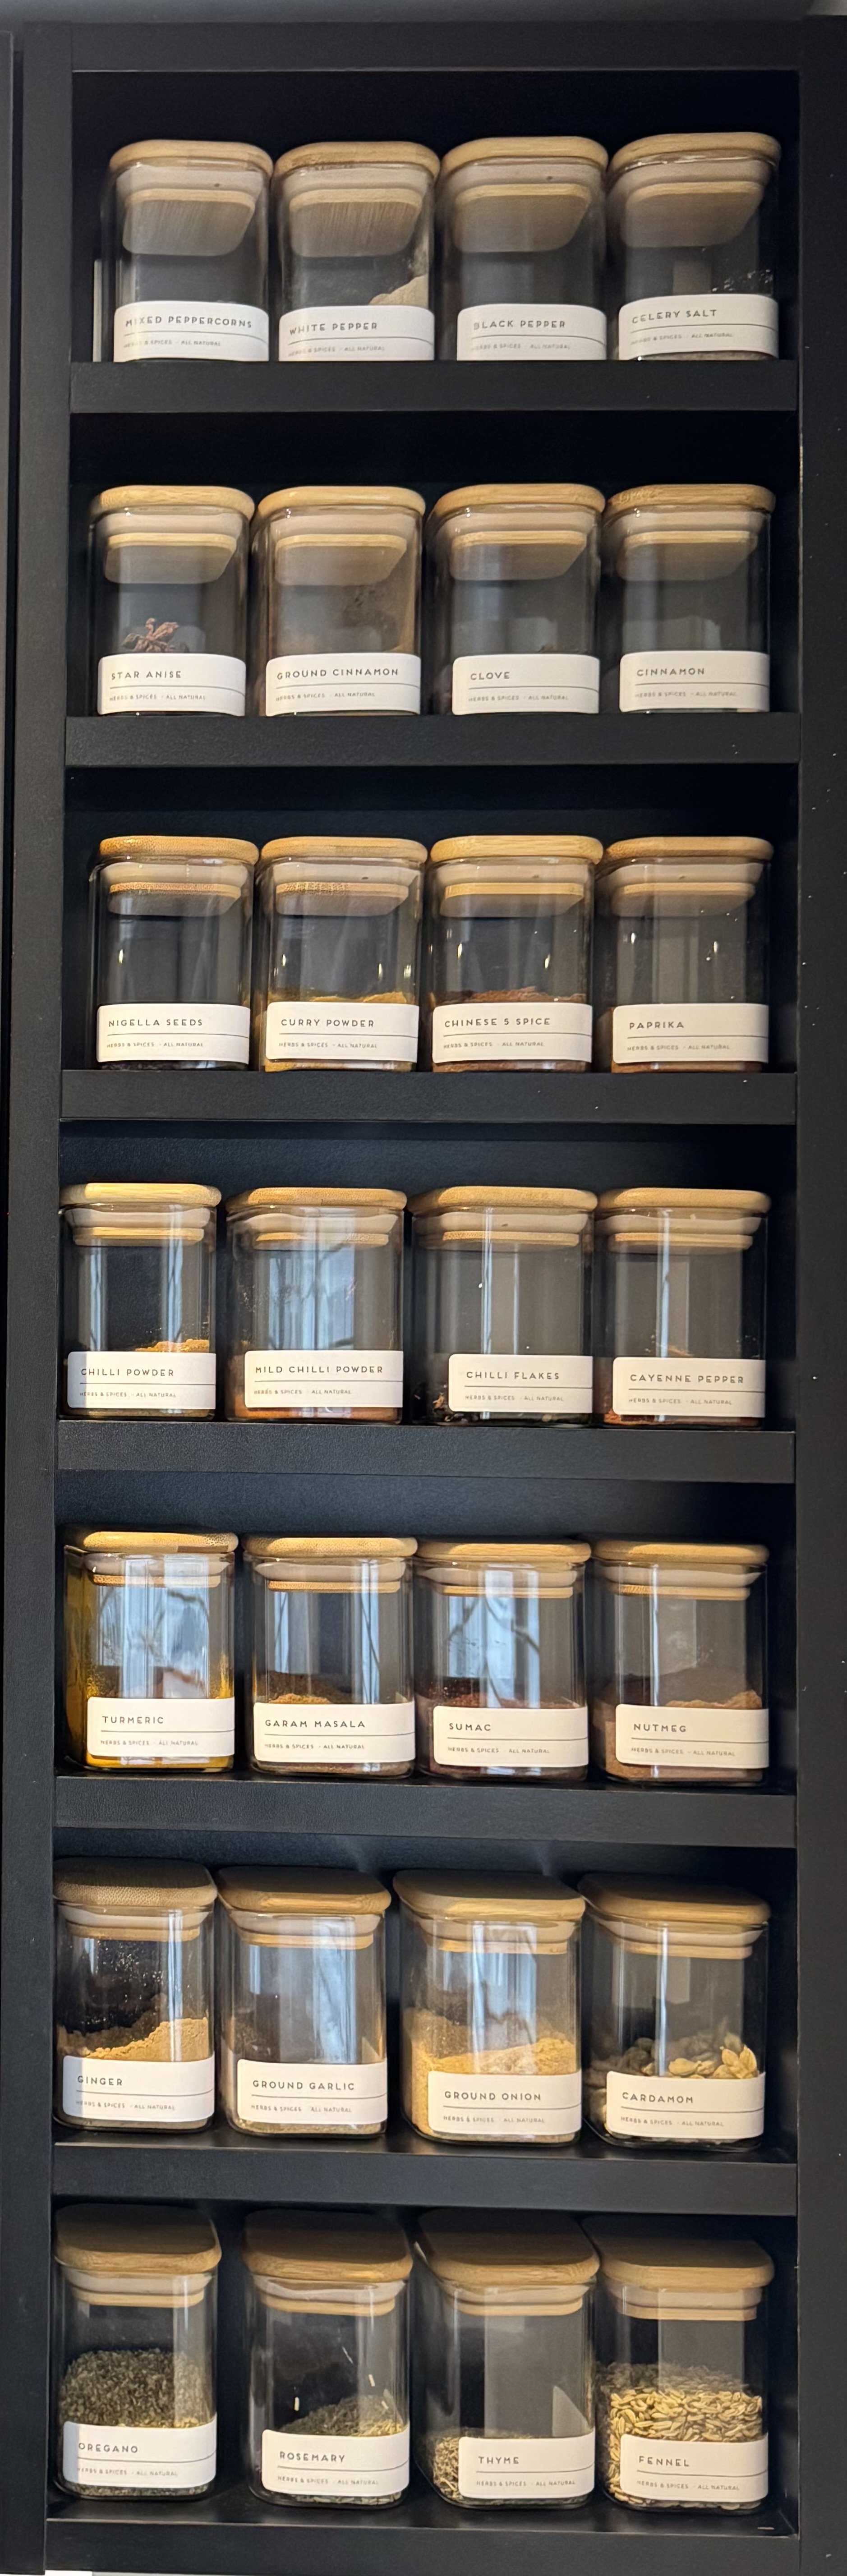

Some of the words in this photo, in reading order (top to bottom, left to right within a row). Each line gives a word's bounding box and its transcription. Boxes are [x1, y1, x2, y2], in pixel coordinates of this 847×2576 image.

[125, 316, 161, 327] MIXED
[168, 316, 252, 328] PEPPERCORNS
[632, 311, 680, 324] CELERY
[290, 323, 325, 335] WHITE
[332, 322, 377, 331] PEPPER
[474, 320, 514, 330] BLACK
[520, 320, 565, 328] PEPPER
[111, 671, 139, 680] STAR
[146, 671, 181, 679] ANISE
[277, 669, 327, 680] GROUND
[332, 668, 398, 676] CINNAMON
[470, 672, 510, 680] CLOVE
[637, 668, 704, 676] CINNAMON
[445, 1018, 497, 1027] CHINESE
[629, 1021, 684, 1030] PAPRIKA
[630, 1374, 691, 1382] CAYENNE
[449, 1723, 491, 1731] SUMAC
[634, 1724, 686, 1732] NUTMEG
[78, 2075, 122, 2086] GINGER
[253, 2080, 303, 2089] GROUND
[445, 2091, 496, 2100] GROUND
[622, 2092, 693, 2103] CARDAMOM
[78, 2443, 138, 2453] OREGANO
[280, 2451, 345, 2462] ROSEMARY
[639, 2456, 689, 2467] FENNEL
